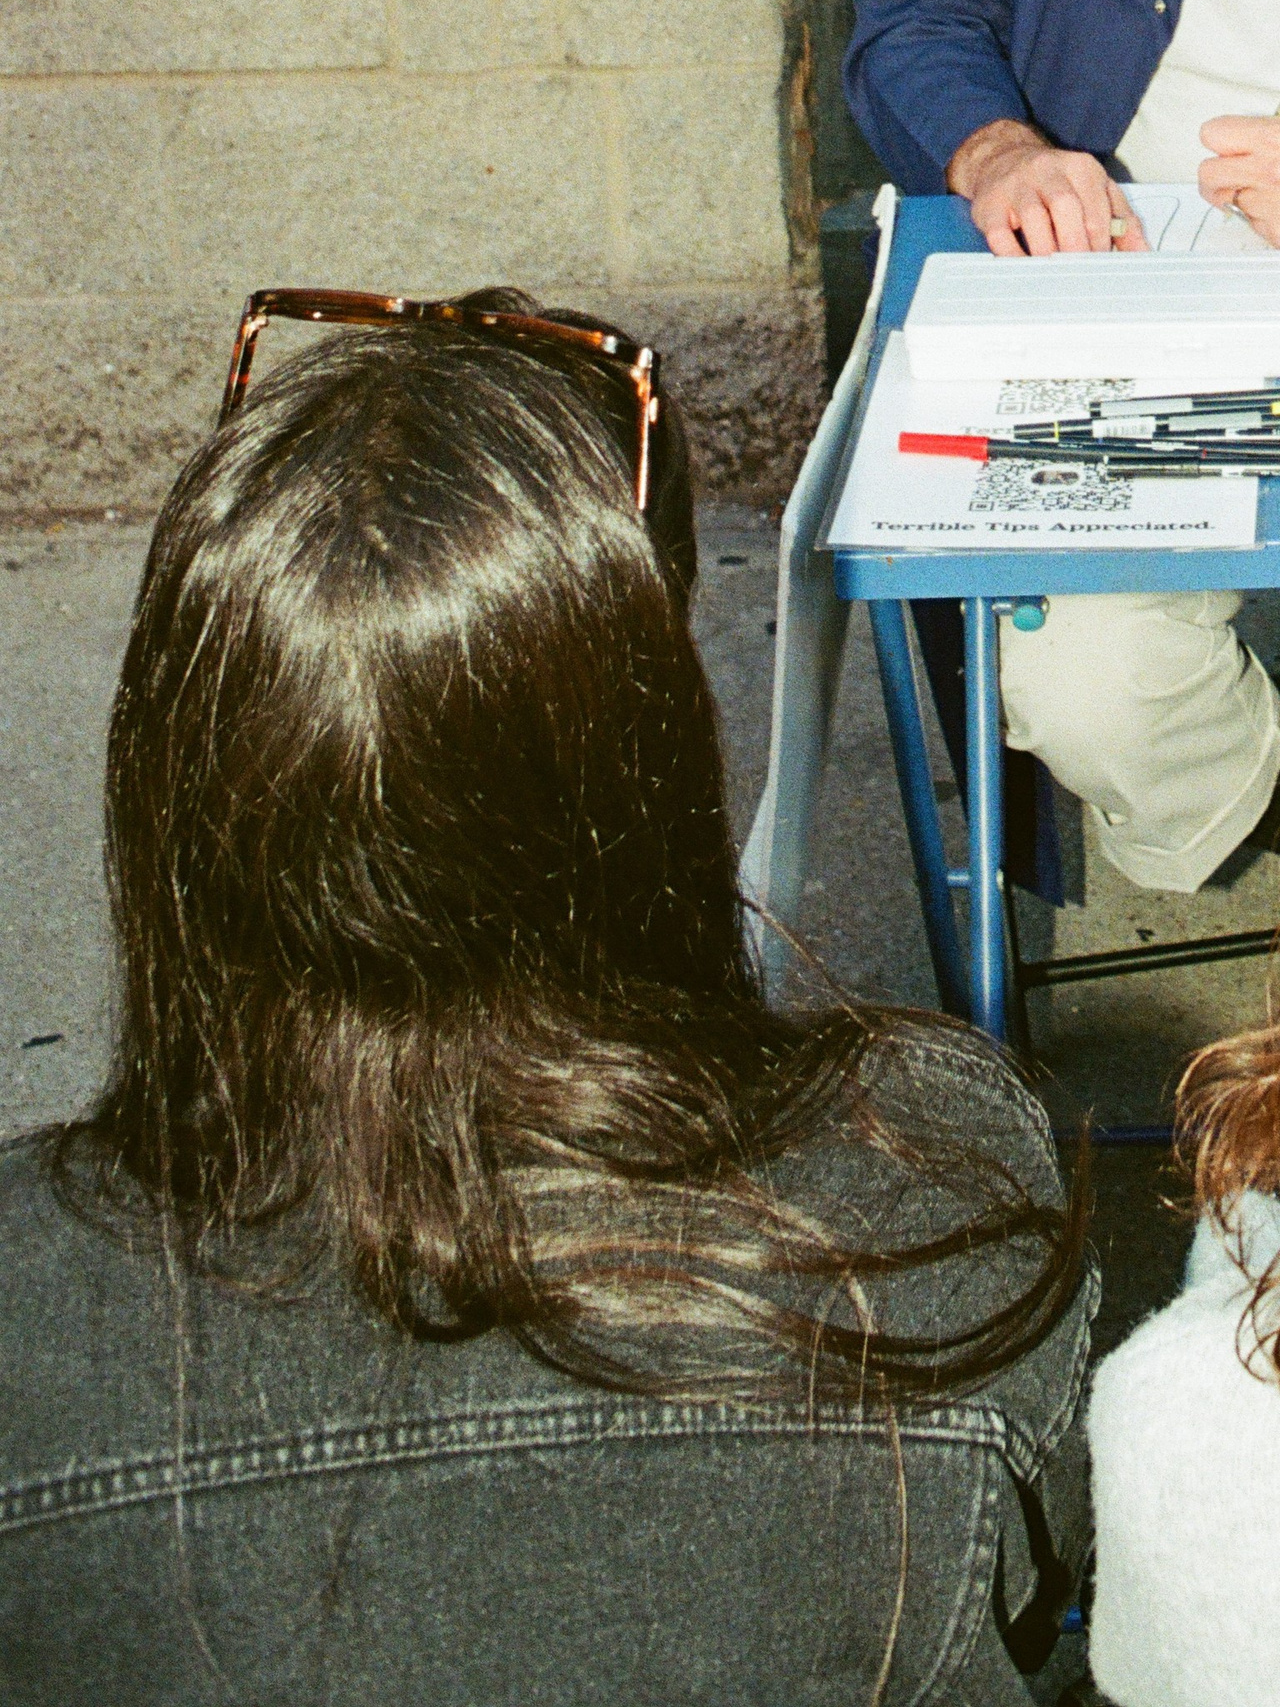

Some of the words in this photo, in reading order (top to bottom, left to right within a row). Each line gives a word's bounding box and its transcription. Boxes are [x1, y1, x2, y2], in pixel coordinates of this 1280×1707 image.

[871, 520, 976, 531] Terrible
[985, 521, 1040, 533] Tips
[1048, 520, 1216, 533] Appreciated.
